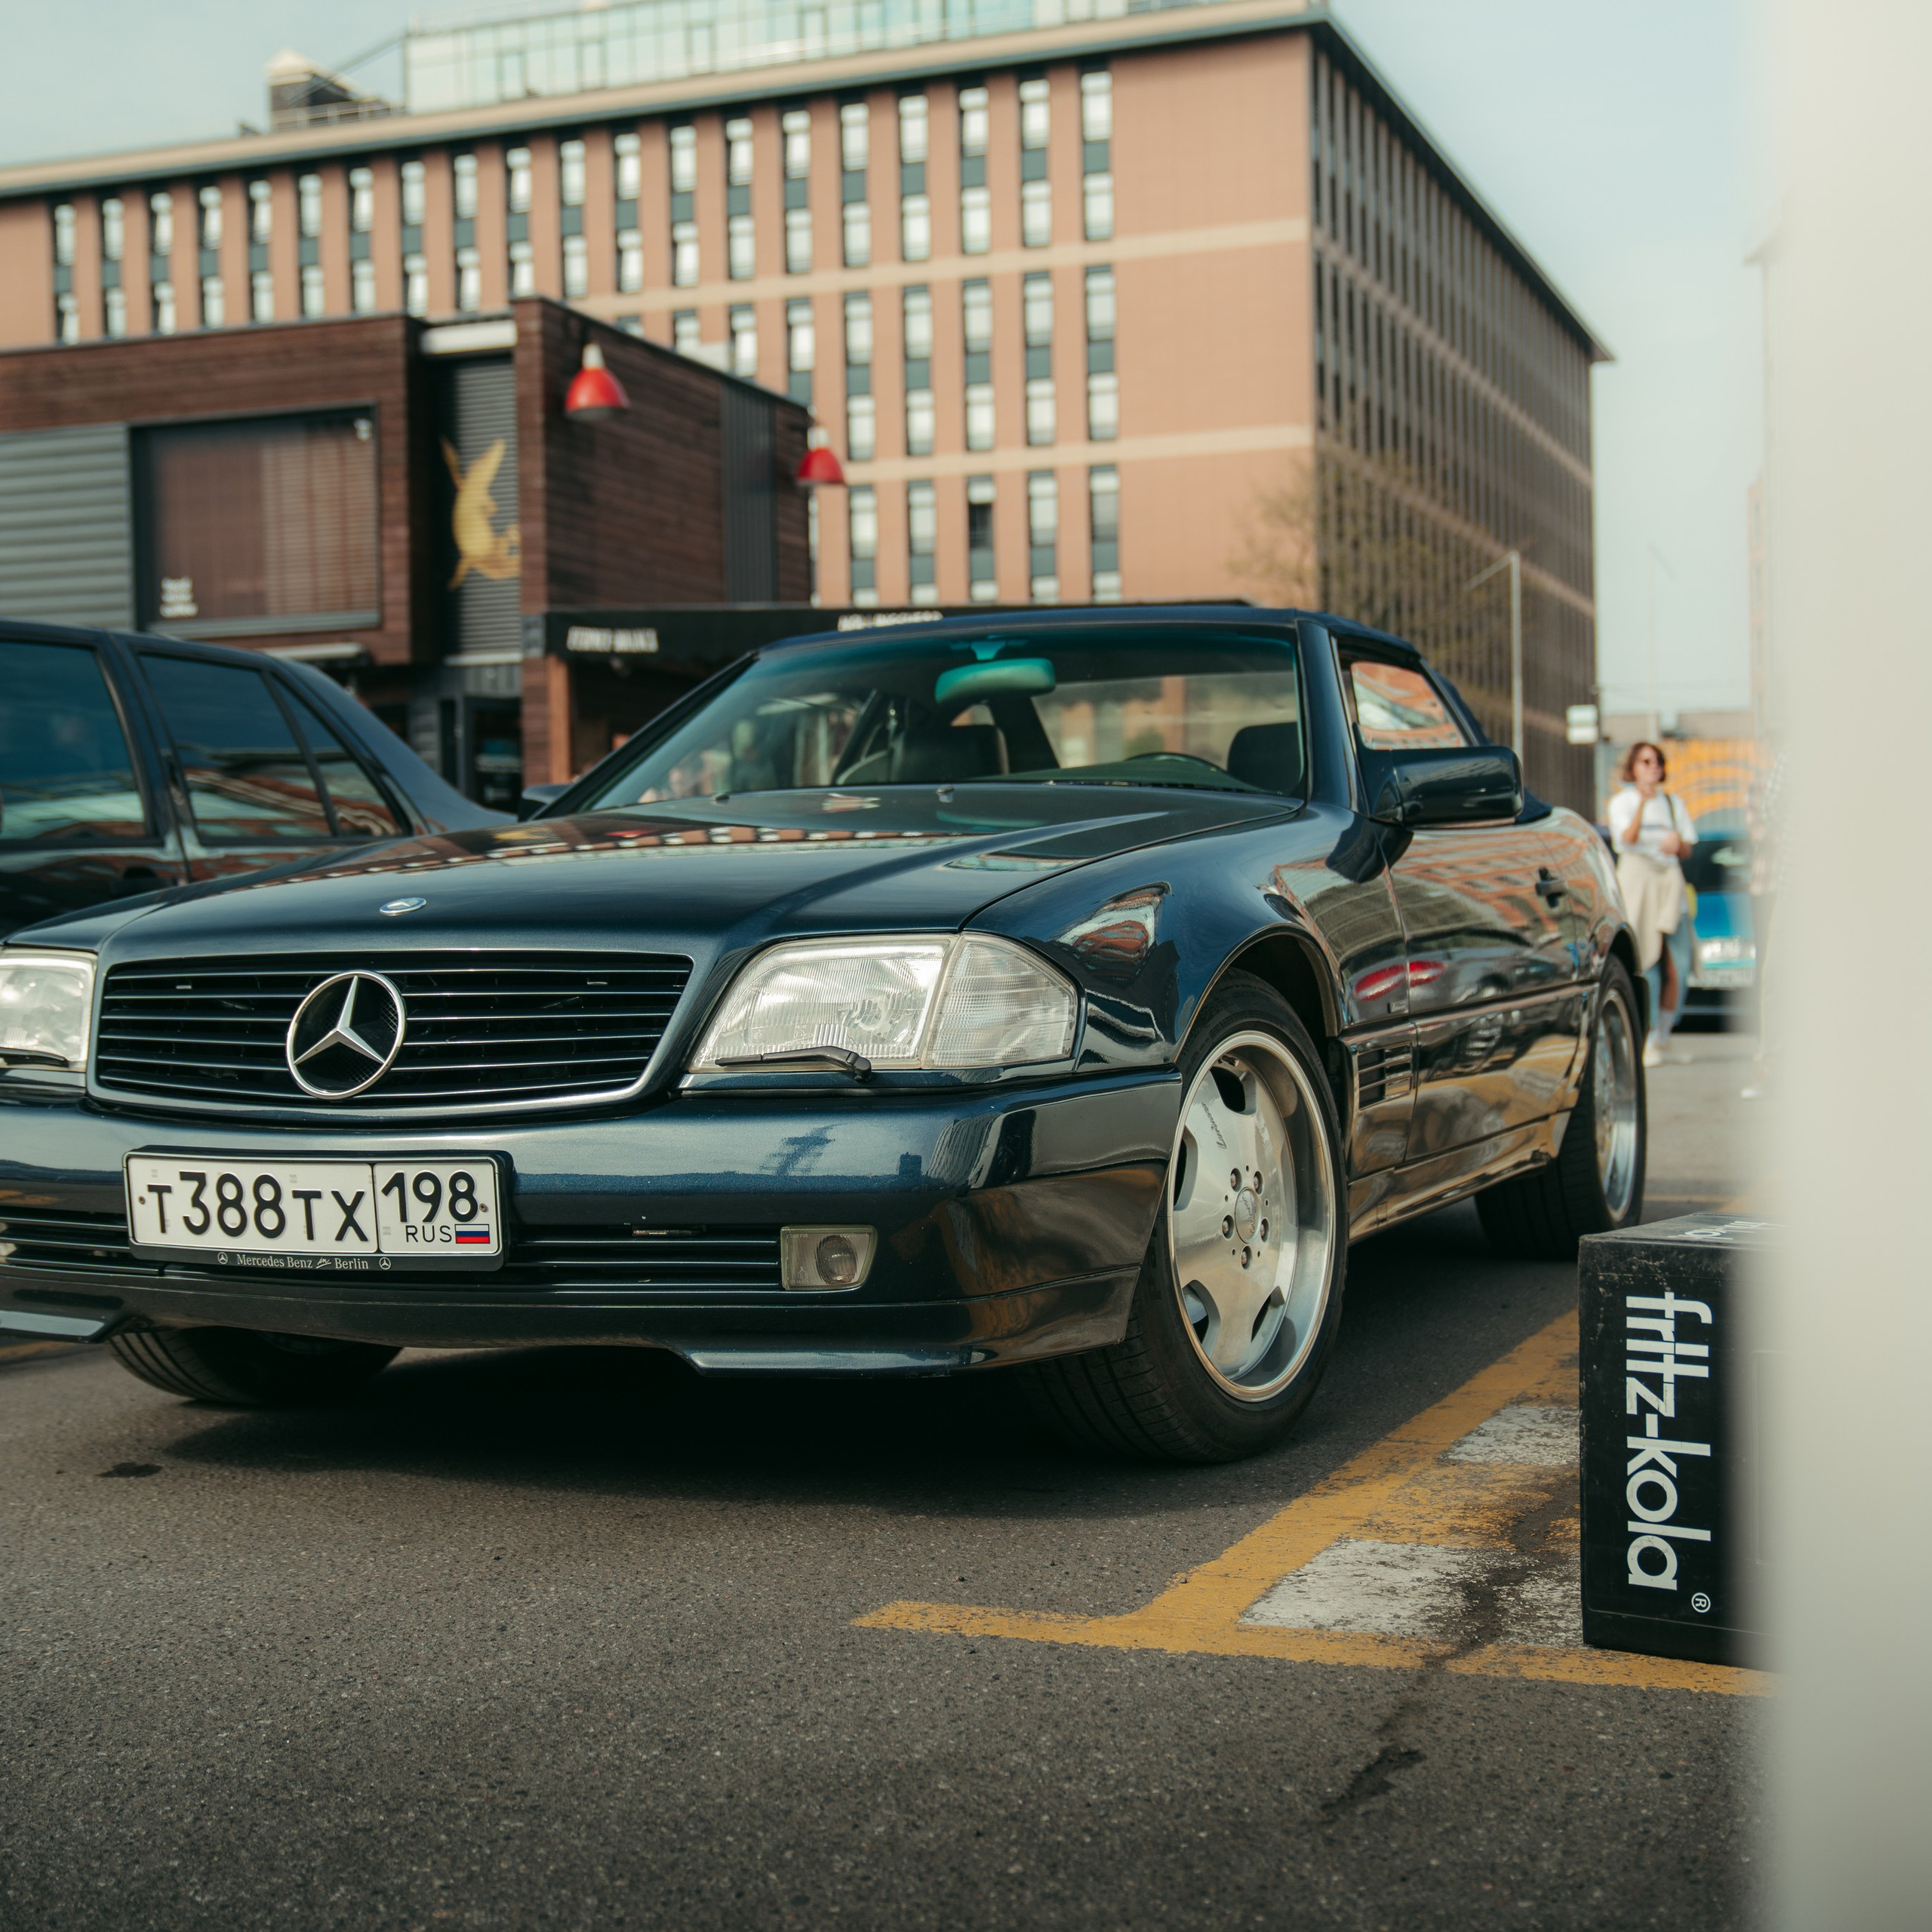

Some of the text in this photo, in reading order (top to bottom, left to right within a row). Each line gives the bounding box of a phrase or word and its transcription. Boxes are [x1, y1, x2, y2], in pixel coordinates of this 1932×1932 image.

[380, 1170, 478, 1223] 198
[405, 1224, 453, 1244] RUS
[236, 1254, 285, 1268] Mercedes
[287, 1257, 313, 1269] Benz
[335, 1257, 369, 1270] Berlin
[1626, 1291, 1713, 1591] fritz-kola
